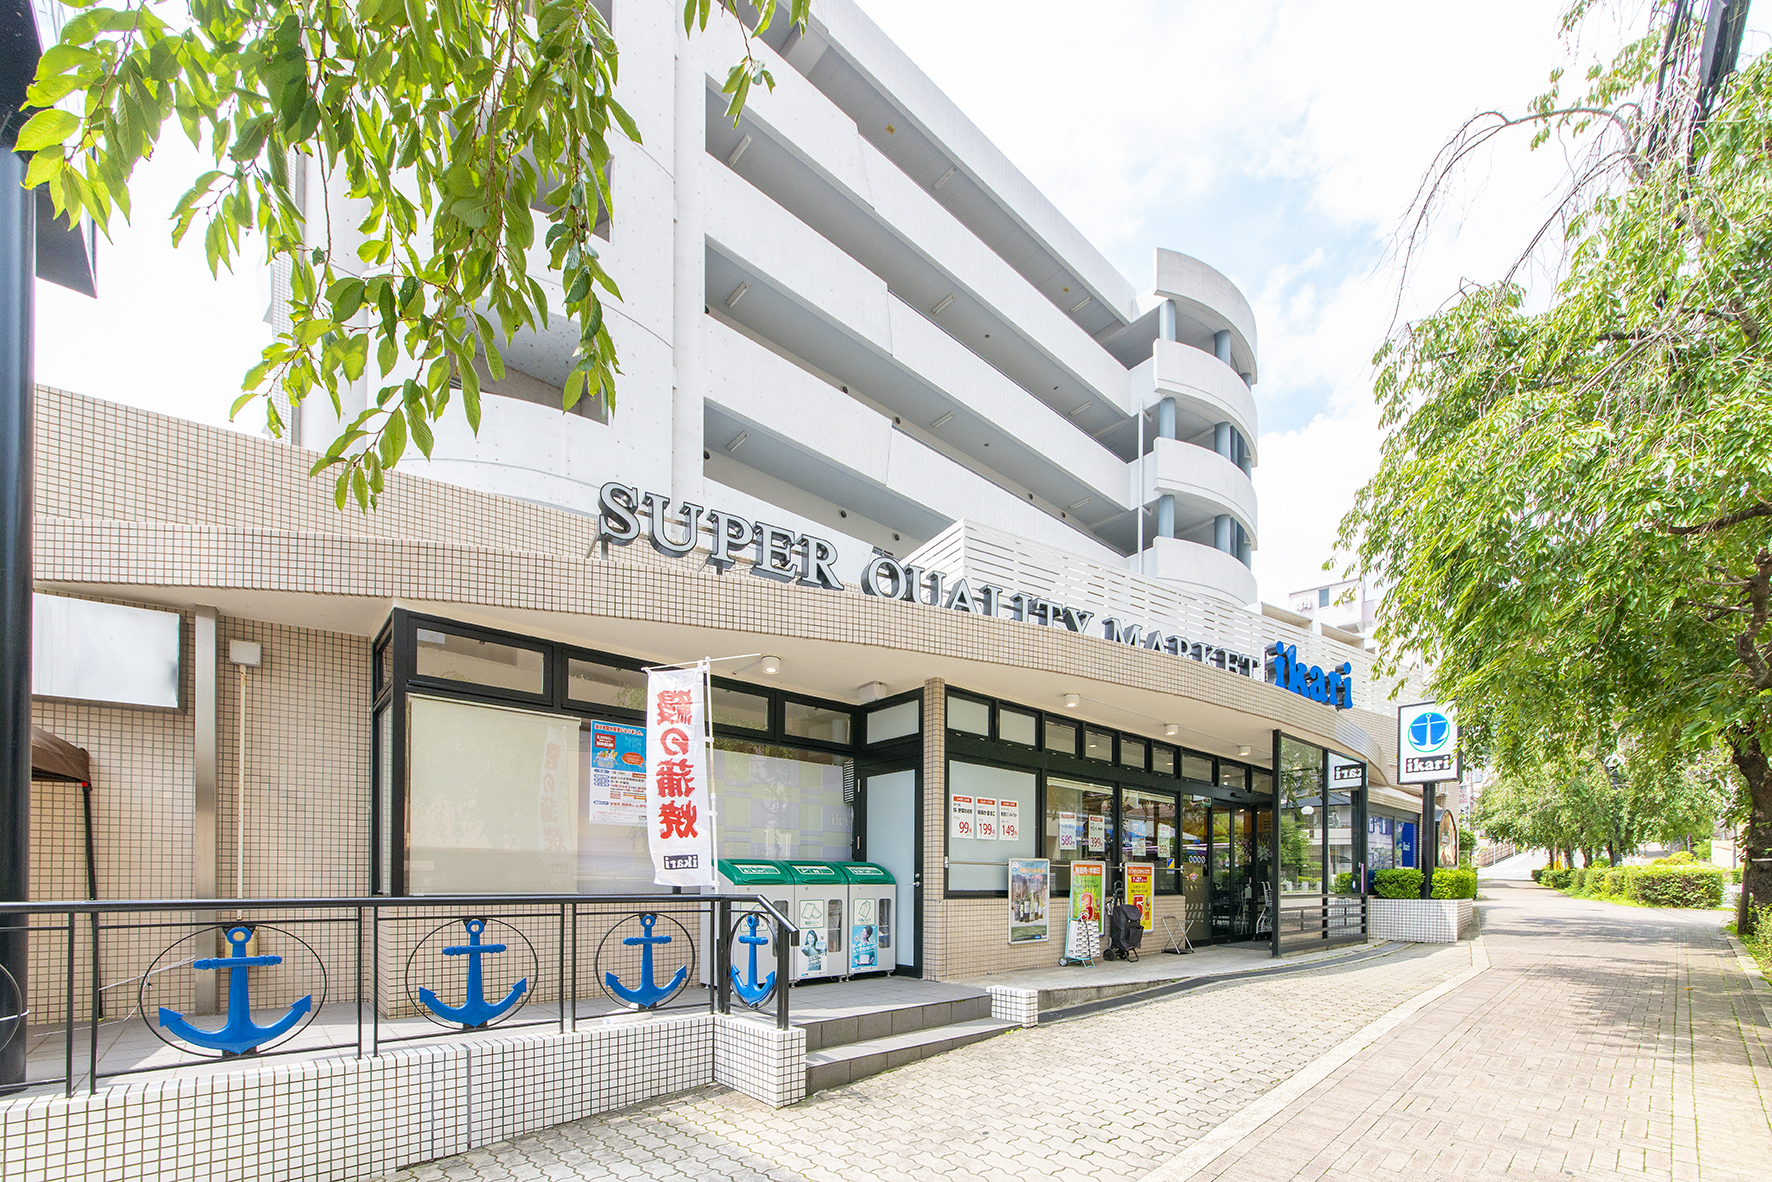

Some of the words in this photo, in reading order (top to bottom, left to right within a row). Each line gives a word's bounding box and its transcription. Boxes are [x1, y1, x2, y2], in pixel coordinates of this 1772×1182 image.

[598, 481, 844, 591] SUPER
[861, 557, 1094, 634] QUALITY
[1102, 618, 1260, 678] MARKET
[1269, 641, 1353, 710] ikari
[1407, 755, 1451, 773] ikari
[831, 813, 850, 826] ika
